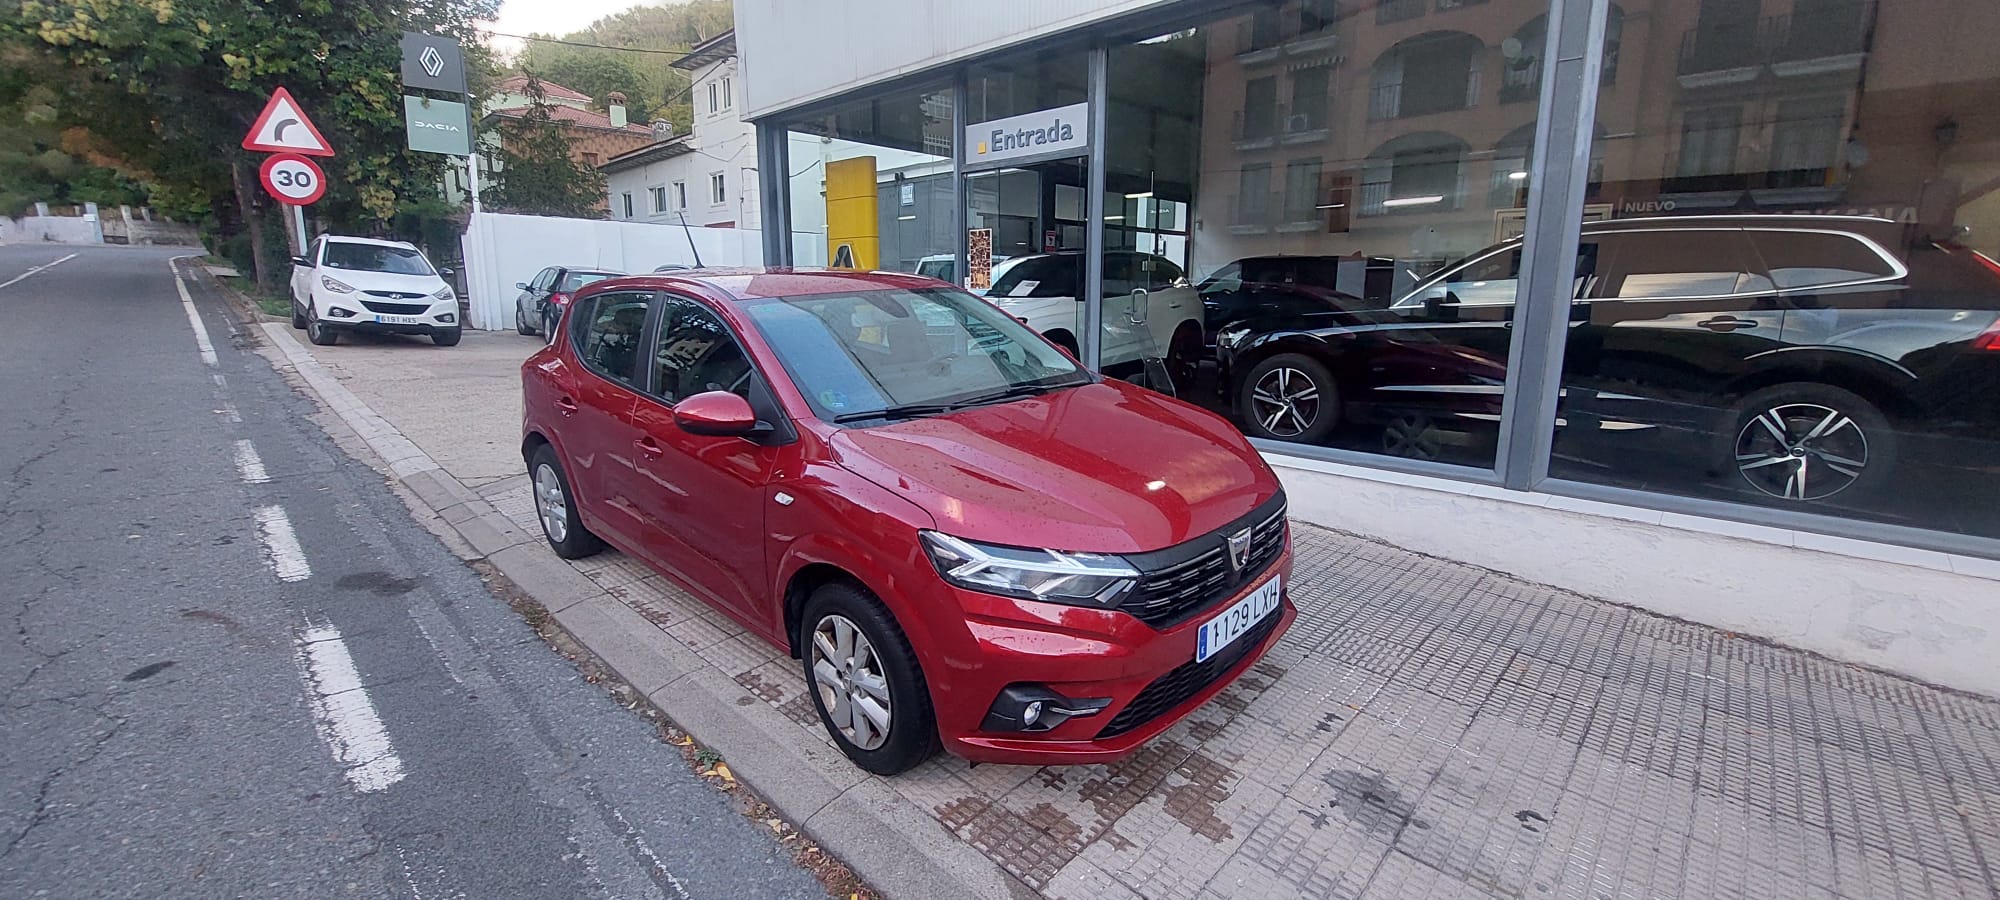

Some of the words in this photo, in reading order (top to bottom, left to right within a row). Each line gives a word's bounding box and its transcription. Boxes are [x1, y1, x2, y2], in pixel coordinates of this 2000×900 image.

[414, 120, 460, 132] DACIA
[991, 118, 1074, 152] Entrada
[277, 169, 311, 188] 30
[1625, 200, 1676, 213] NUEVO
[1213, 603, 1250, 648] 1129
[1252, 580, 1278, 621] LXH
